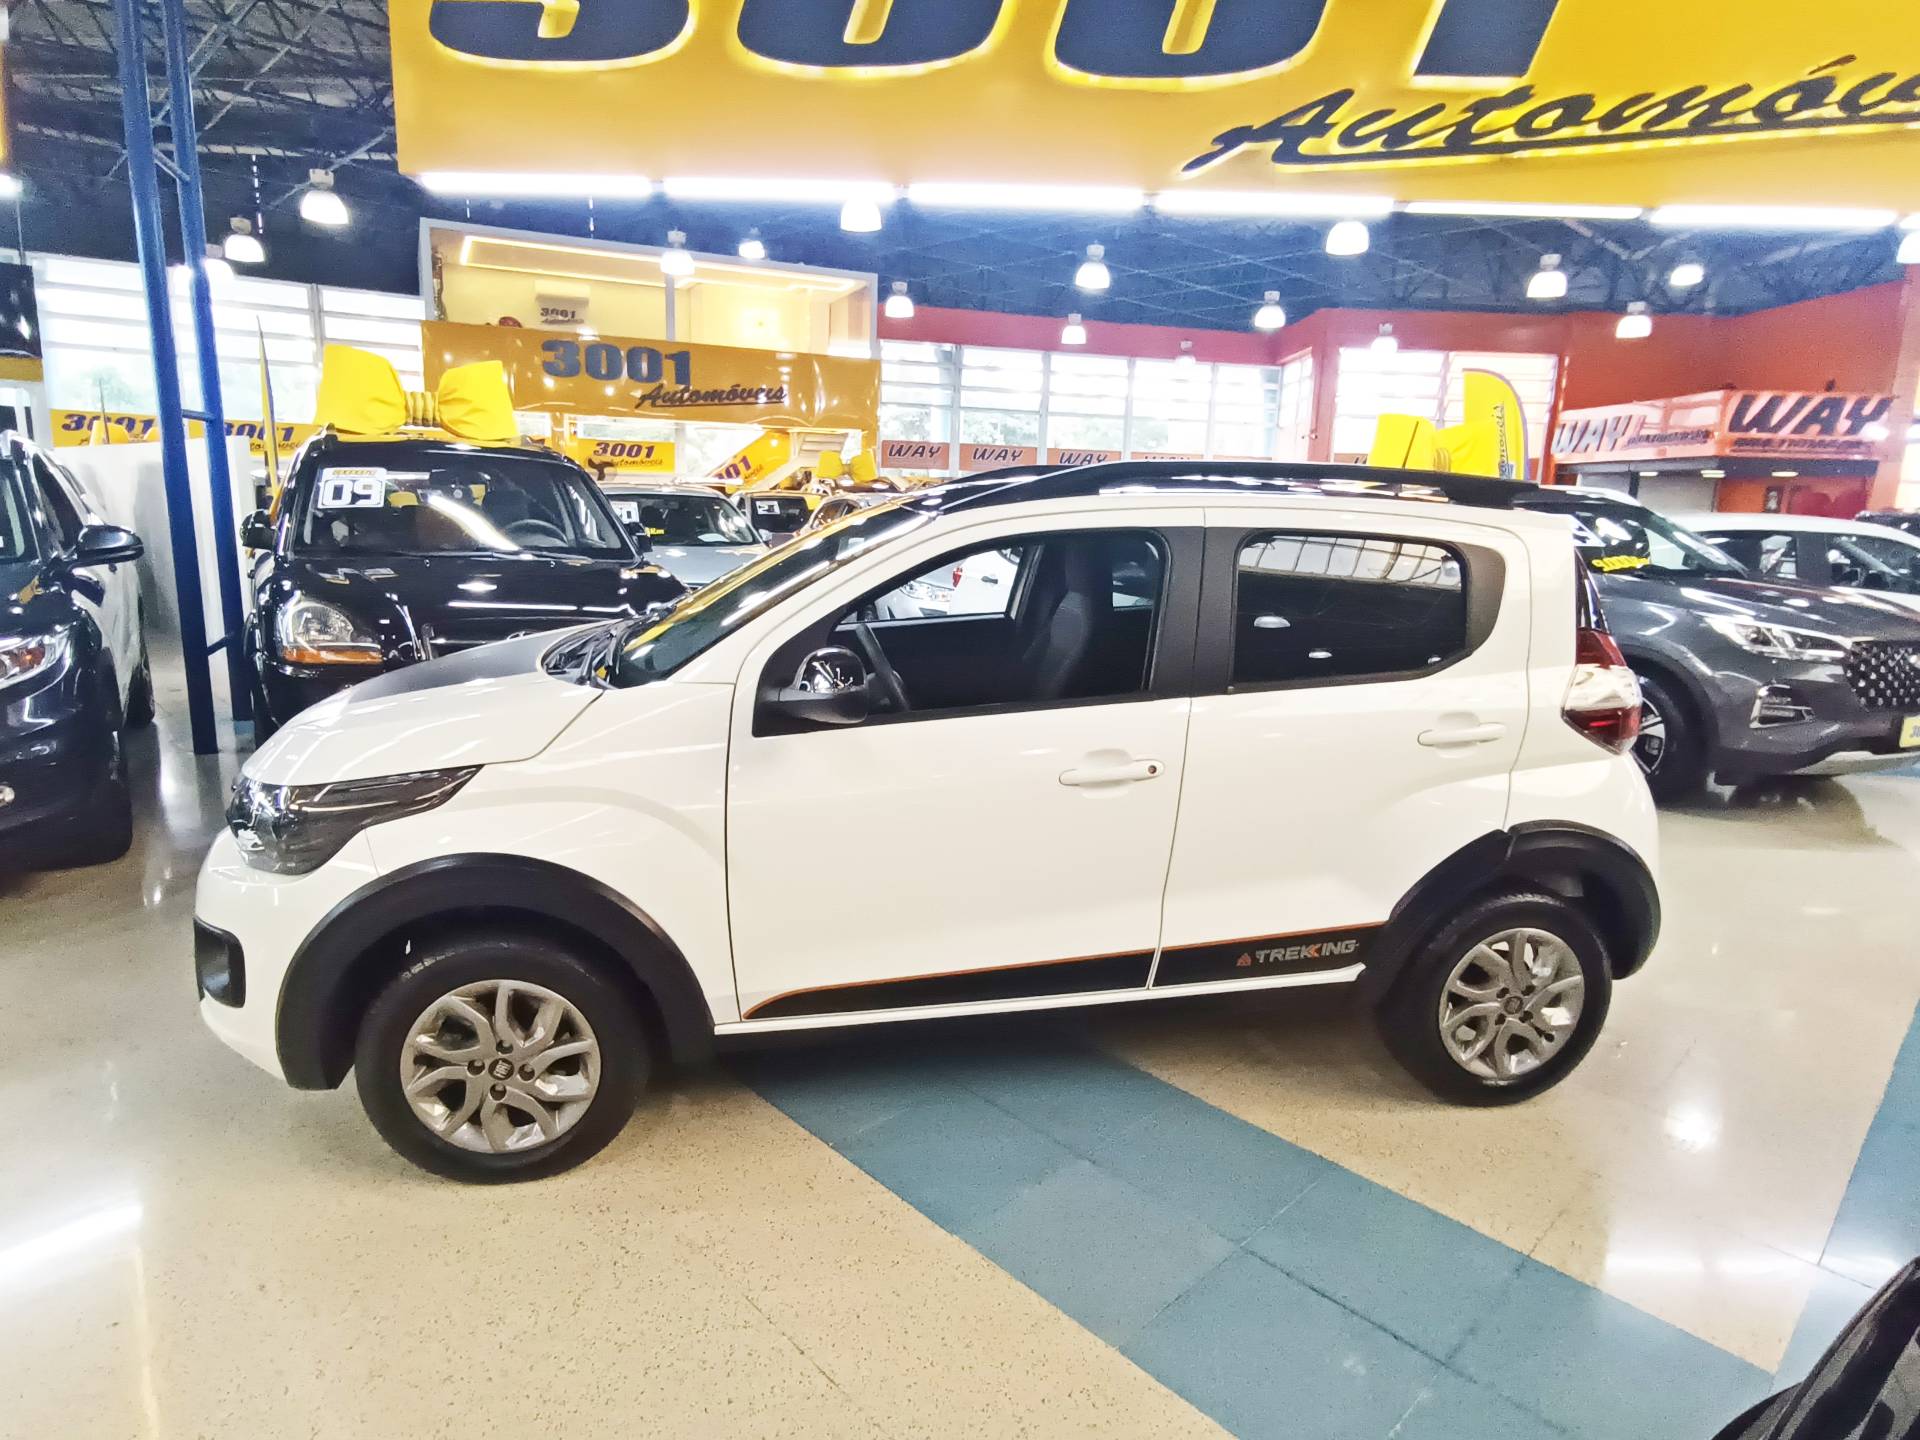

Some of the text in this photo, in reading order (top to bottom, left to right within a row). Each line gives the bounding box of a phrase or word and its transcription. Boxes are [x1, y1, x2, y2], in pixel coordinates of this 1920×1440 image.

[541, 340, 691, 385] 3001
[634, 383, 788, 408] Automóveis
[1728, 394, 1894, 436] WAY
[1552, 414, 1633, 453] WAY
[593, 442, 655, 459] 3001
[888, 444, 942, 458] WAY
[972, 447, 1024, 461] WAY
[322, 478, 383, 506] 09
[1255, 939, 1358, 963] TREKKING
